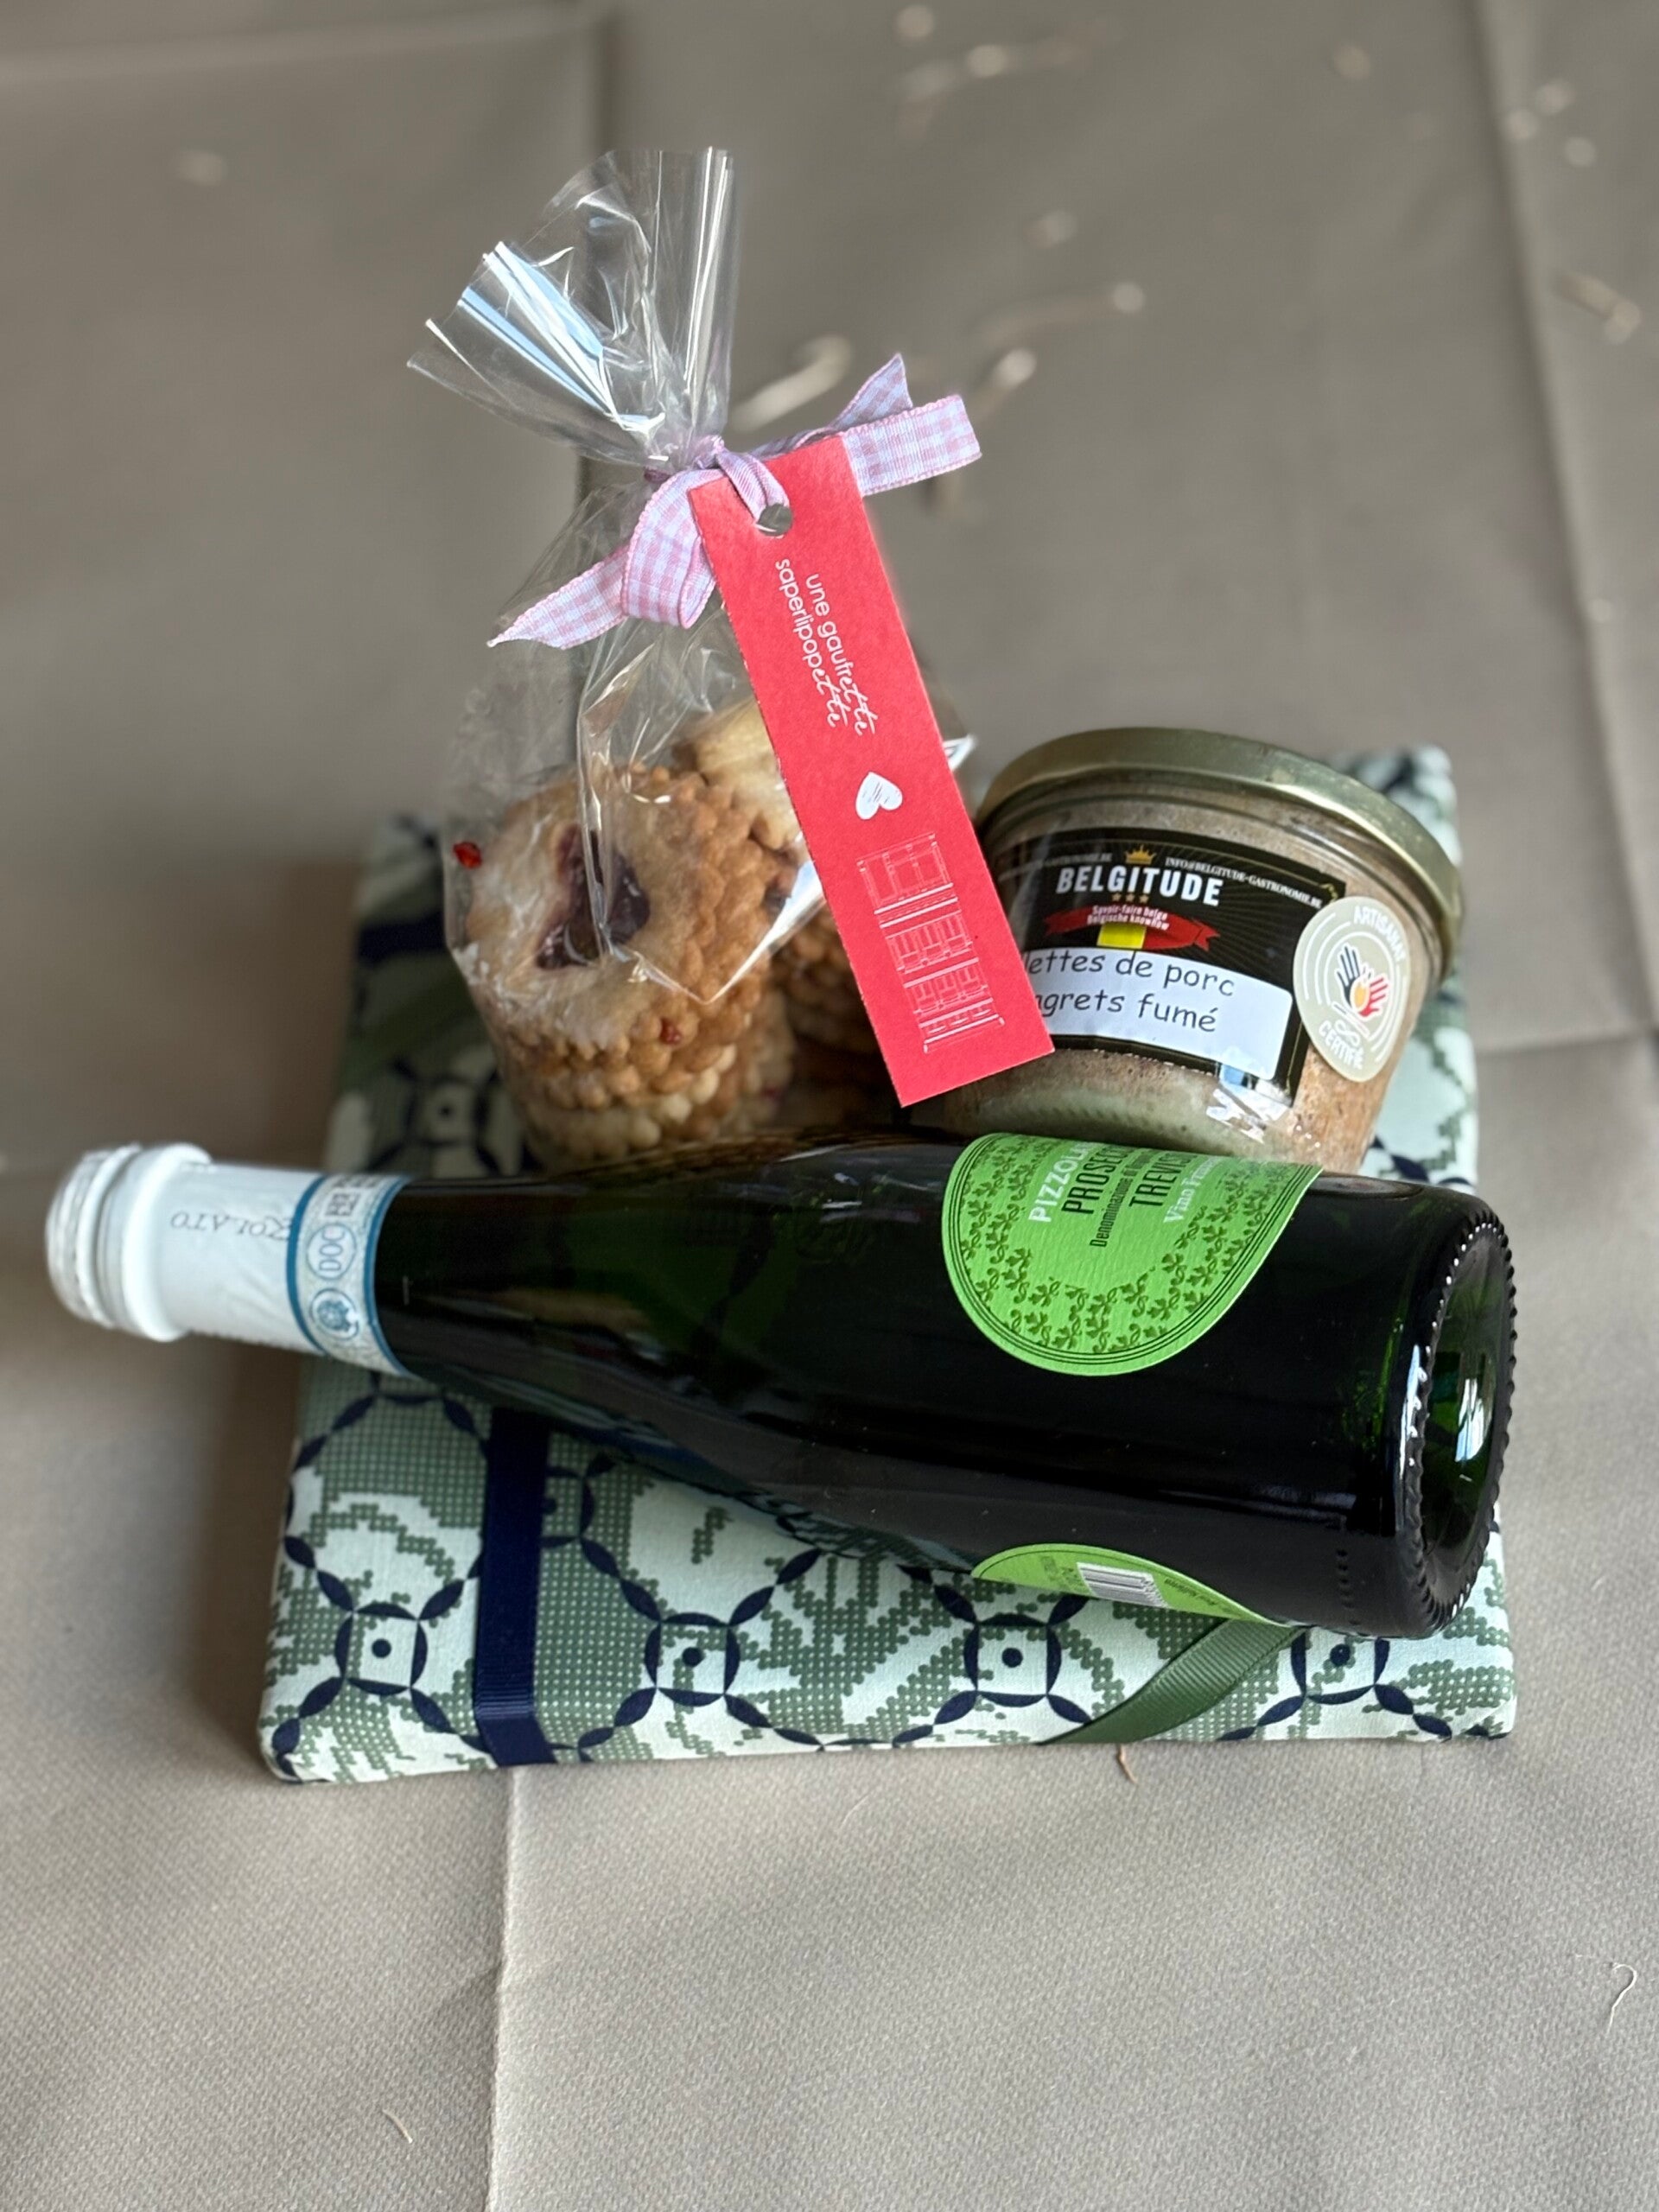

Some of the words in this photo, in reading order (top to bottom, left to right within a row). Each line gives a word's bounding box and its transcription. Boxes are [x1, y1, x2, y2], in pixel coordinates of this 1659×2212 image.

[805, 573, 830, 617] une
[775, 558, 851, 728] saperlipopette
[817, 620, 879, 736] gaufrette
[1055, 864, 1224, 907] BELGITUDE
[1116, 950, 1153, 978] de
[1163, 963, 1235, 997] porc
[1138, 993, 1219, 1033] fumé
[319, 1227, 346, 1272] DOC
